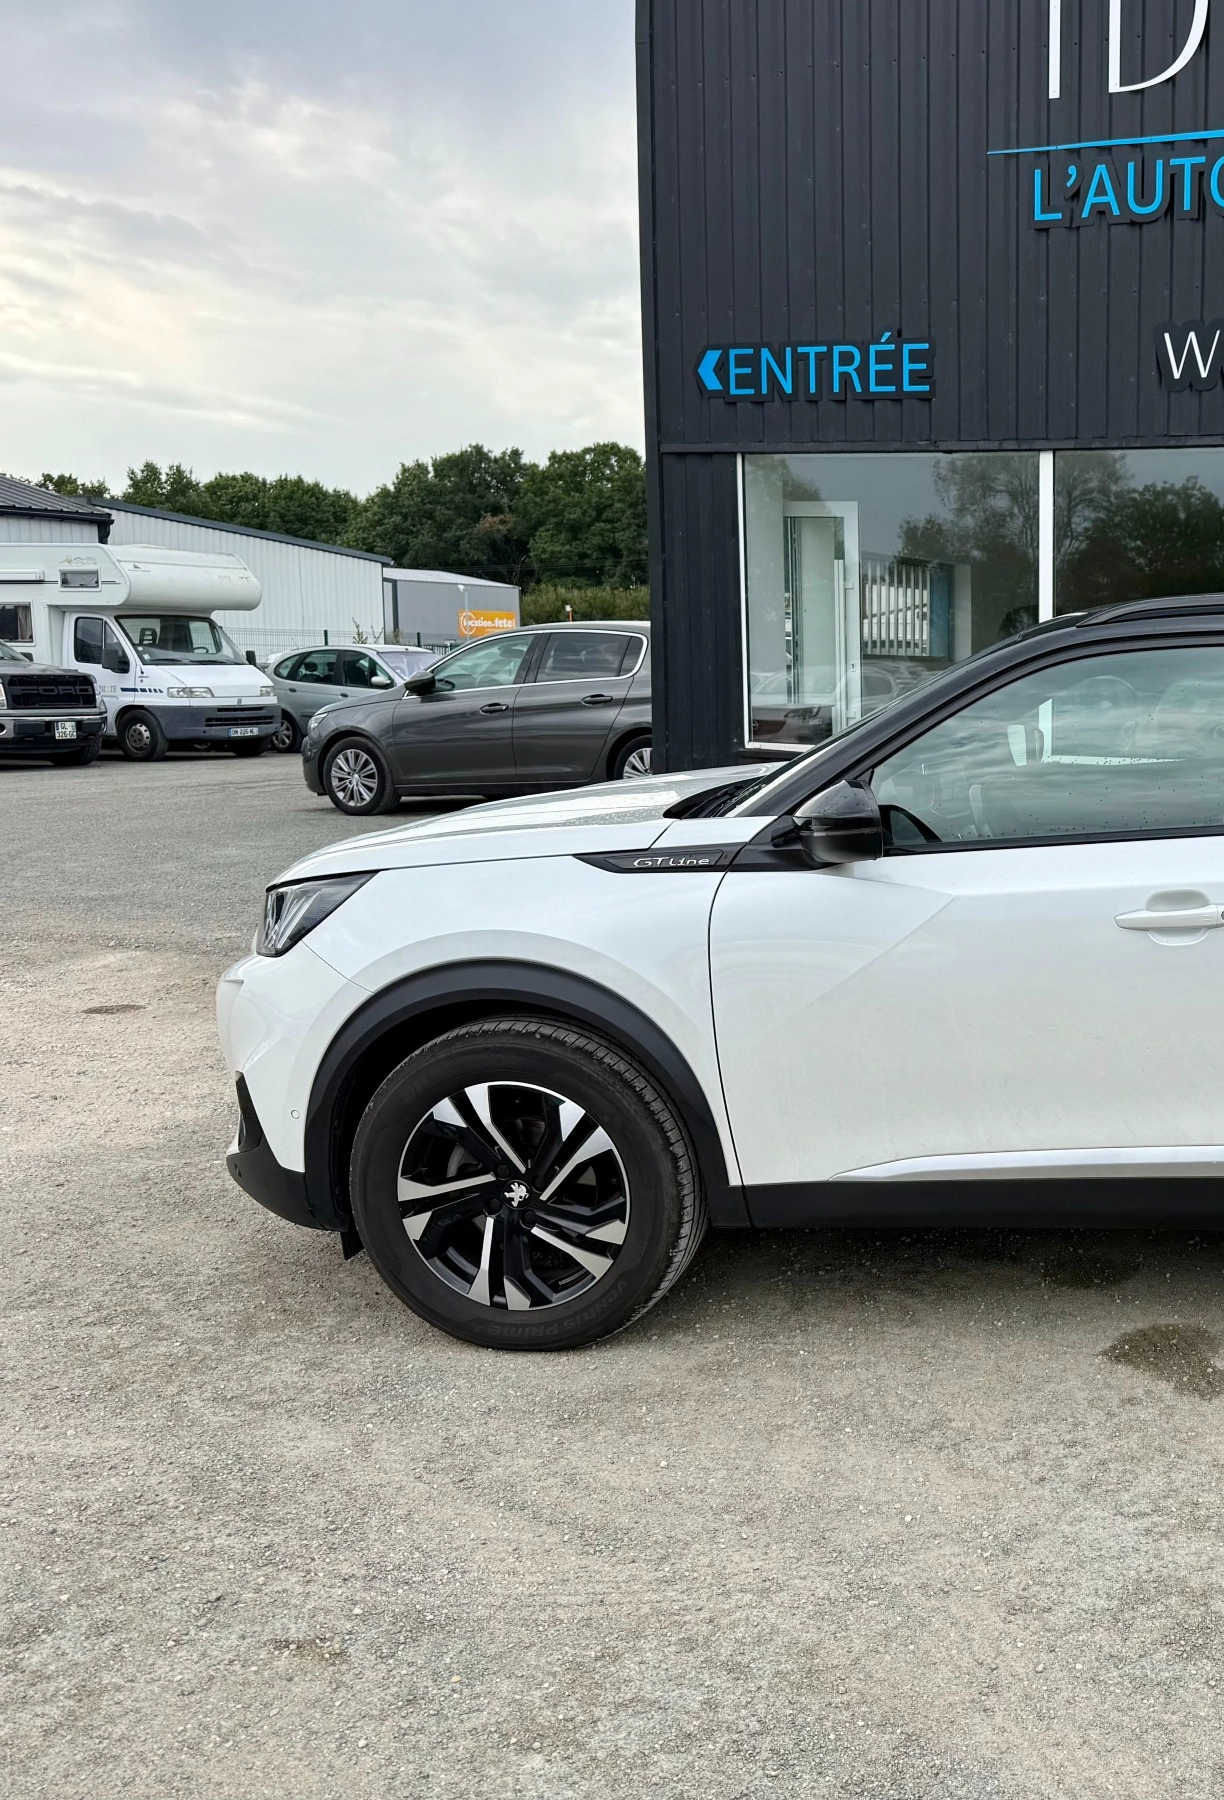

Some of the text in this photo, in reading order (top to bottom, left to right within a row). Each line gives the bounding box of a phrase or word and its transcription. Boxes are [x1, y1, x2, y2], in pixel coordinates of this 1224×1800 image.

[728, 332, 931, 394] ENTRÉE
[16, 685, 93, 695] FORD
[633, 857, 710, 868] GT Line
